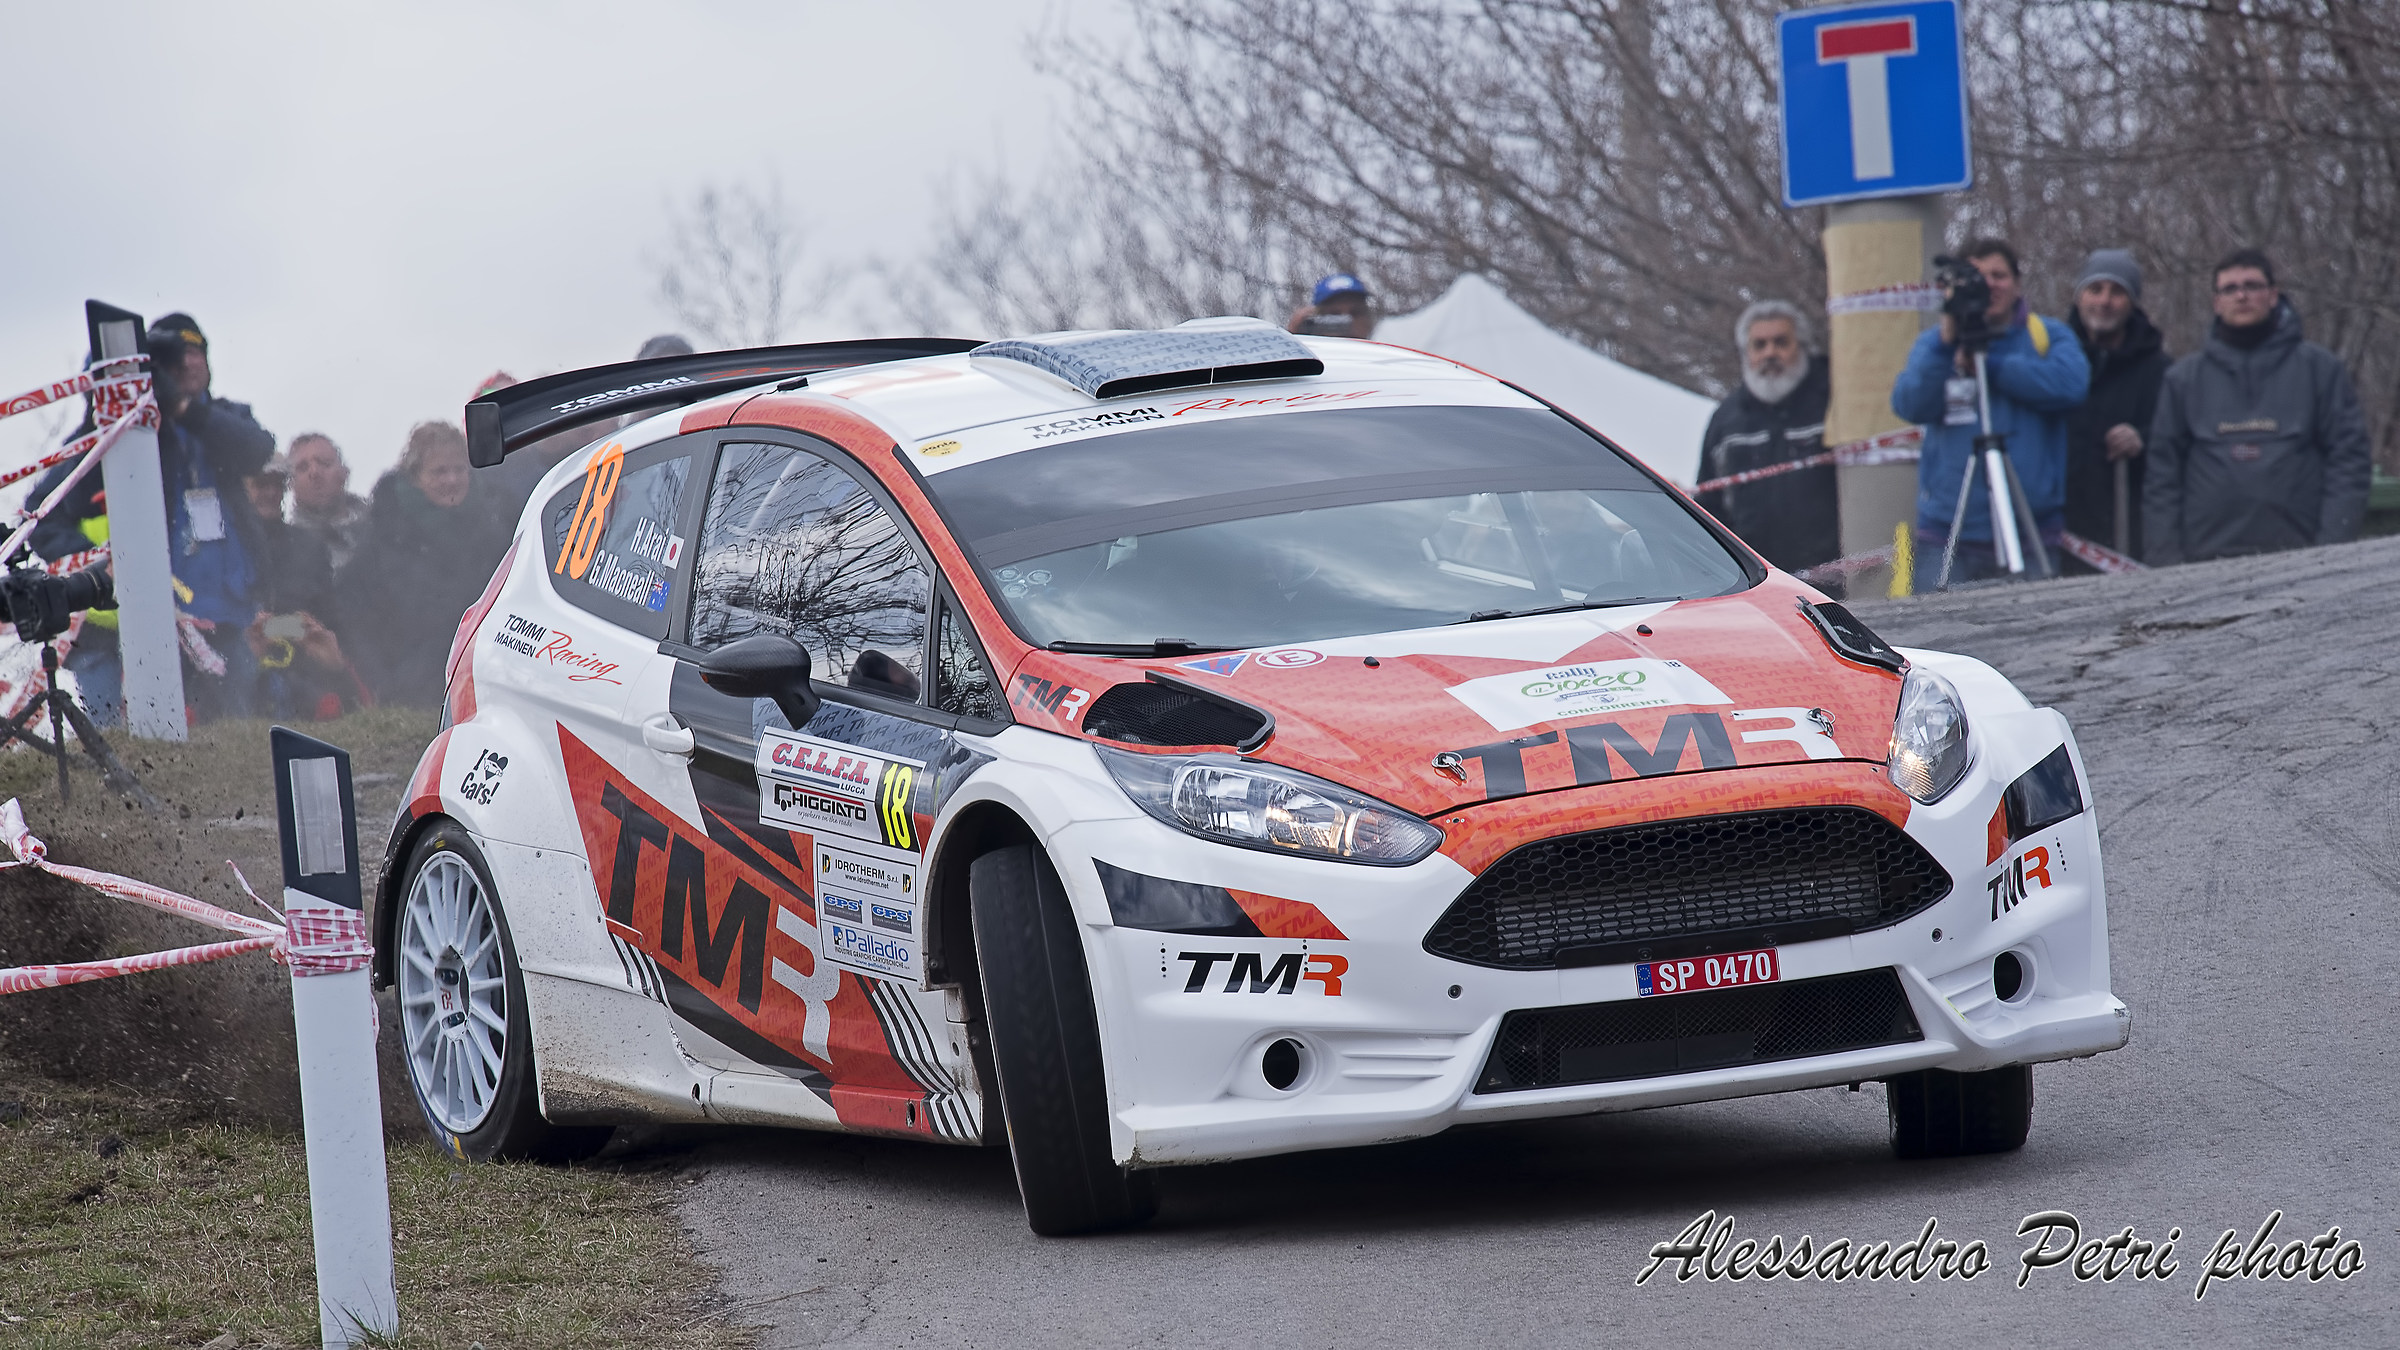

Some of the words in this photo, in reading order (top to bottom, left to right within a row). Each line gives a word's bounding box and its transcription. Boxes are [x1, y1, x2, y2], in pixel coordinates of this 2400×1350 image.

[1024, 407, 1159, 432] TOMMI
[554, 441, 624, 580] 18
[503, 614, 547, 642] TOMMI
[534, 629, 623, 686] Racing
[1013, 673, 1091, 722] TMR
[1557, 698, 1670, 717] CONCORRENTE
[473, 748, 489, 771] I
[1452, 706, 1845, 799] TMR
[460, 771, 501, 806] Cars!
[840, 783, 866, 796] LUCCA
[882, 762, 913, 849] 18
[835, 858, 885, 880] IDROTHERM
[1988, 845, 2053, 923] TMR
[600, 779, 841, 1065] TMR
[845, 928, 909, 963] Palladio
[1177, 951, 1350, 997] TMR
[1640, 987, 1653, 995] EST
[1658, 961, 1695, 993] SP
[1704, 952, 1772, 987] 0470
